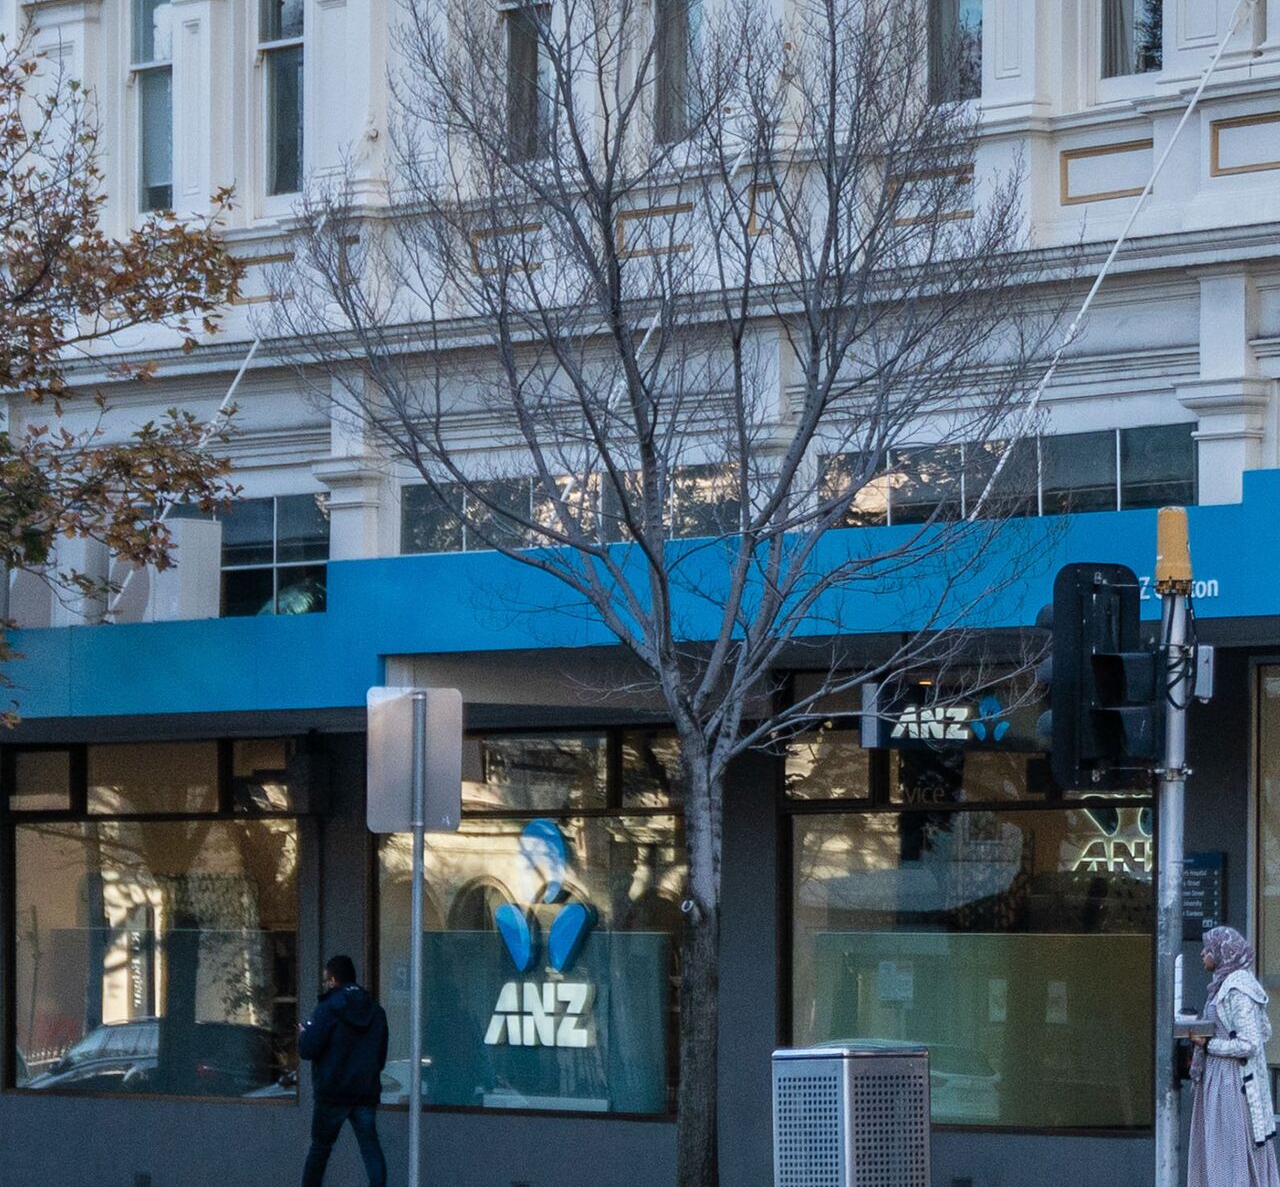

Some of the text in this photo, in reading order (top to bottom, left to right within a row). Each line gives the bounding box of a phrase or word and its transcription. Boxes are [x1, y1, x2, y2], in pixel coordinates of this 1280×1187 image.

[891, 707, 968, 739] ANZ
[1072, 839, 1152, 872] AN
[483, 982, 588, 1048] ANZ
